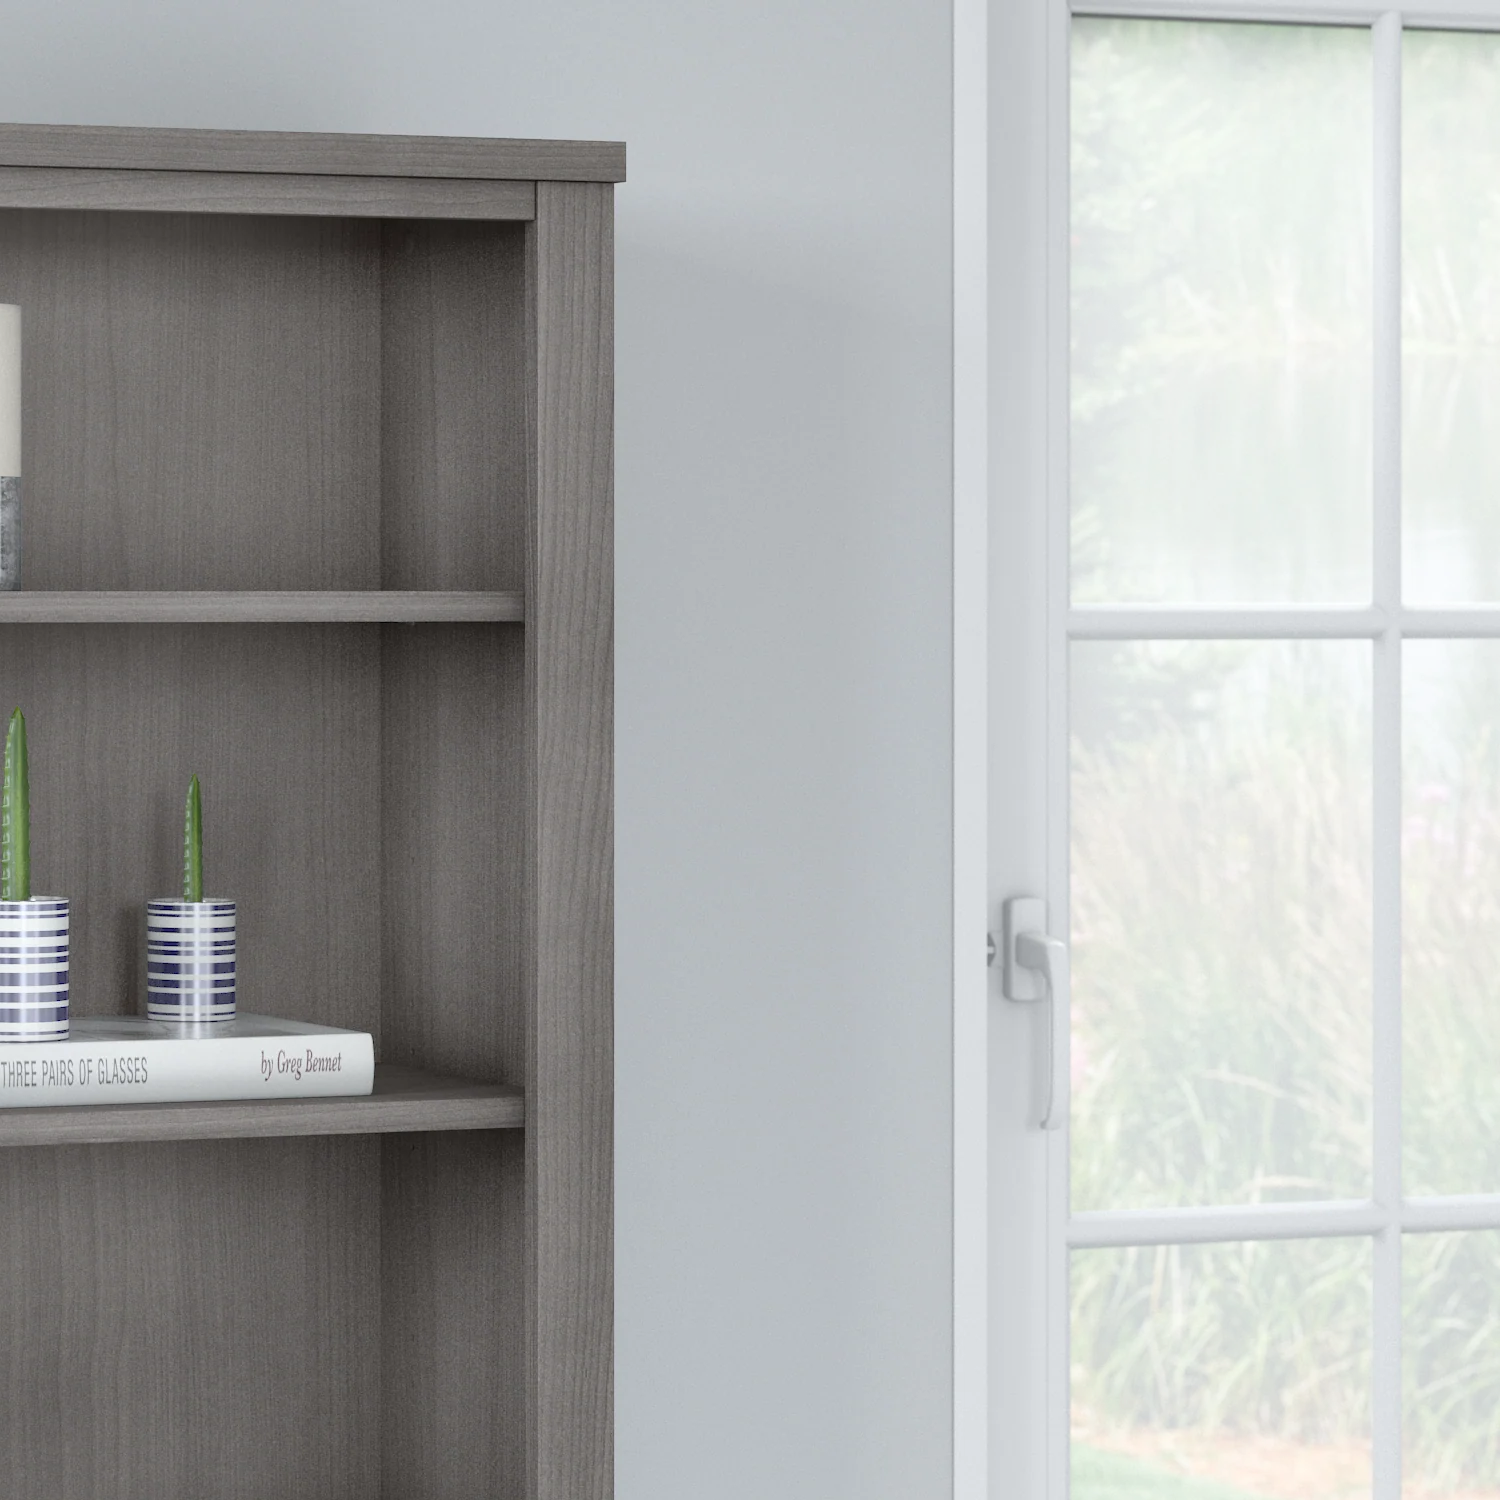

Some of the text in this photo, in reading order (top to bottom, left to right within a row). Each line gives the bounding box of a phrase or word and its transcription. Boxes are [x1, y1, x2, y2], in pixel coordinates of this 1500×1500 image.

[0, 1056, 148, 1088] THREE PAIRS OF GLASSES
[261, 1048, 342, 1082] by Greg Bennet
